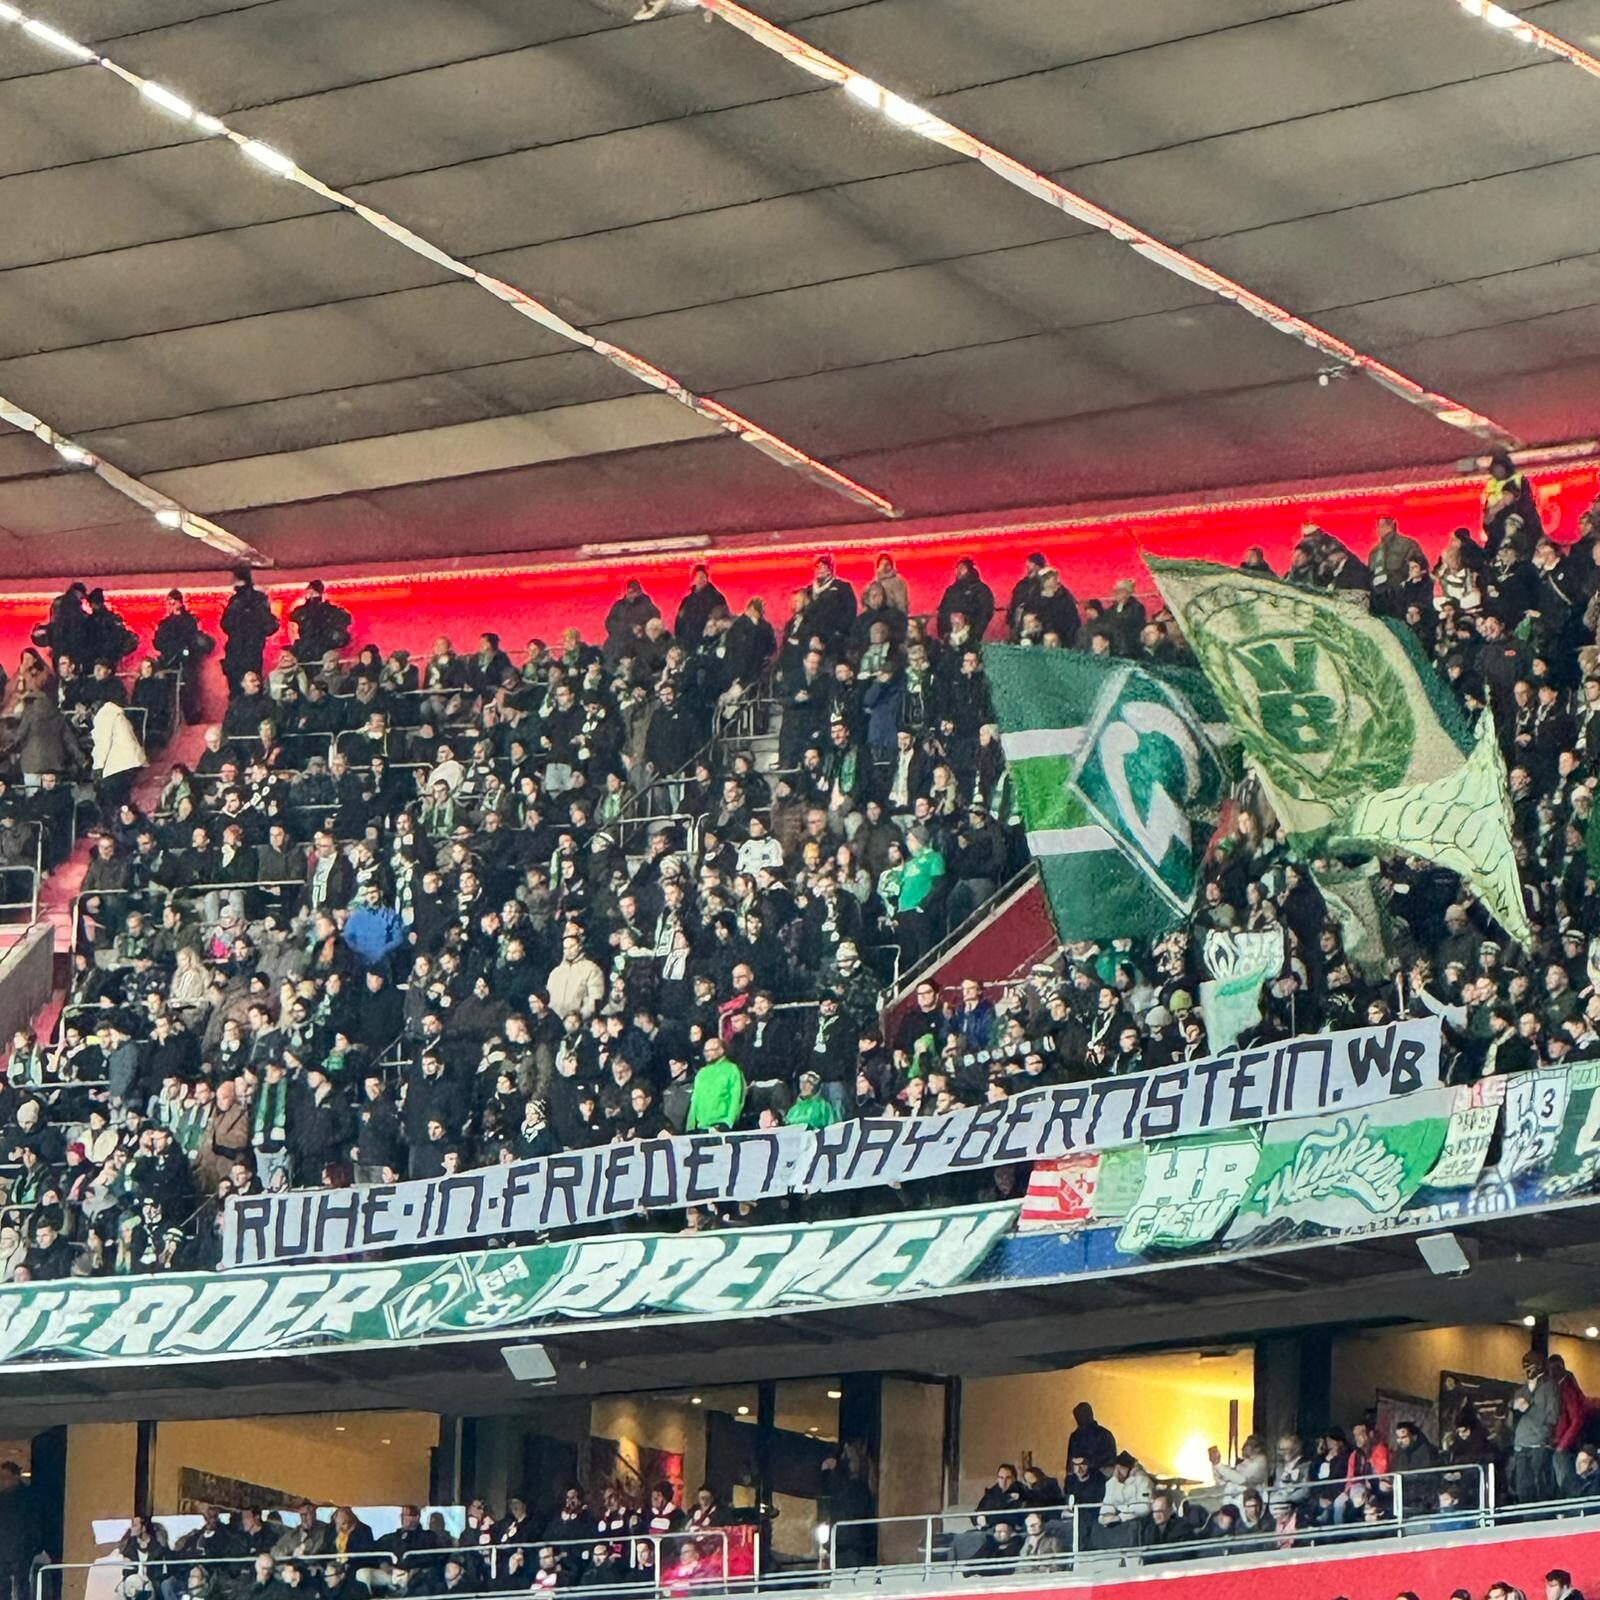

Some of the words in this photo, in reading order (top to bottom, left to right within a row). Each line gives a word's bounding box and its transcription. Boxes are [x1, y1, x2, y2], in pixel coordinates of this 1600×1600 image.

[235, 1187, 397, 1264] RUHE
[501, 1133, 779, 1227] FRIEDEN
[805, 1117, 947, 1184] KAY
[1348, 1026, 1426, 1094] WB
[540, 1209, 1017, 1313] BREMEN
